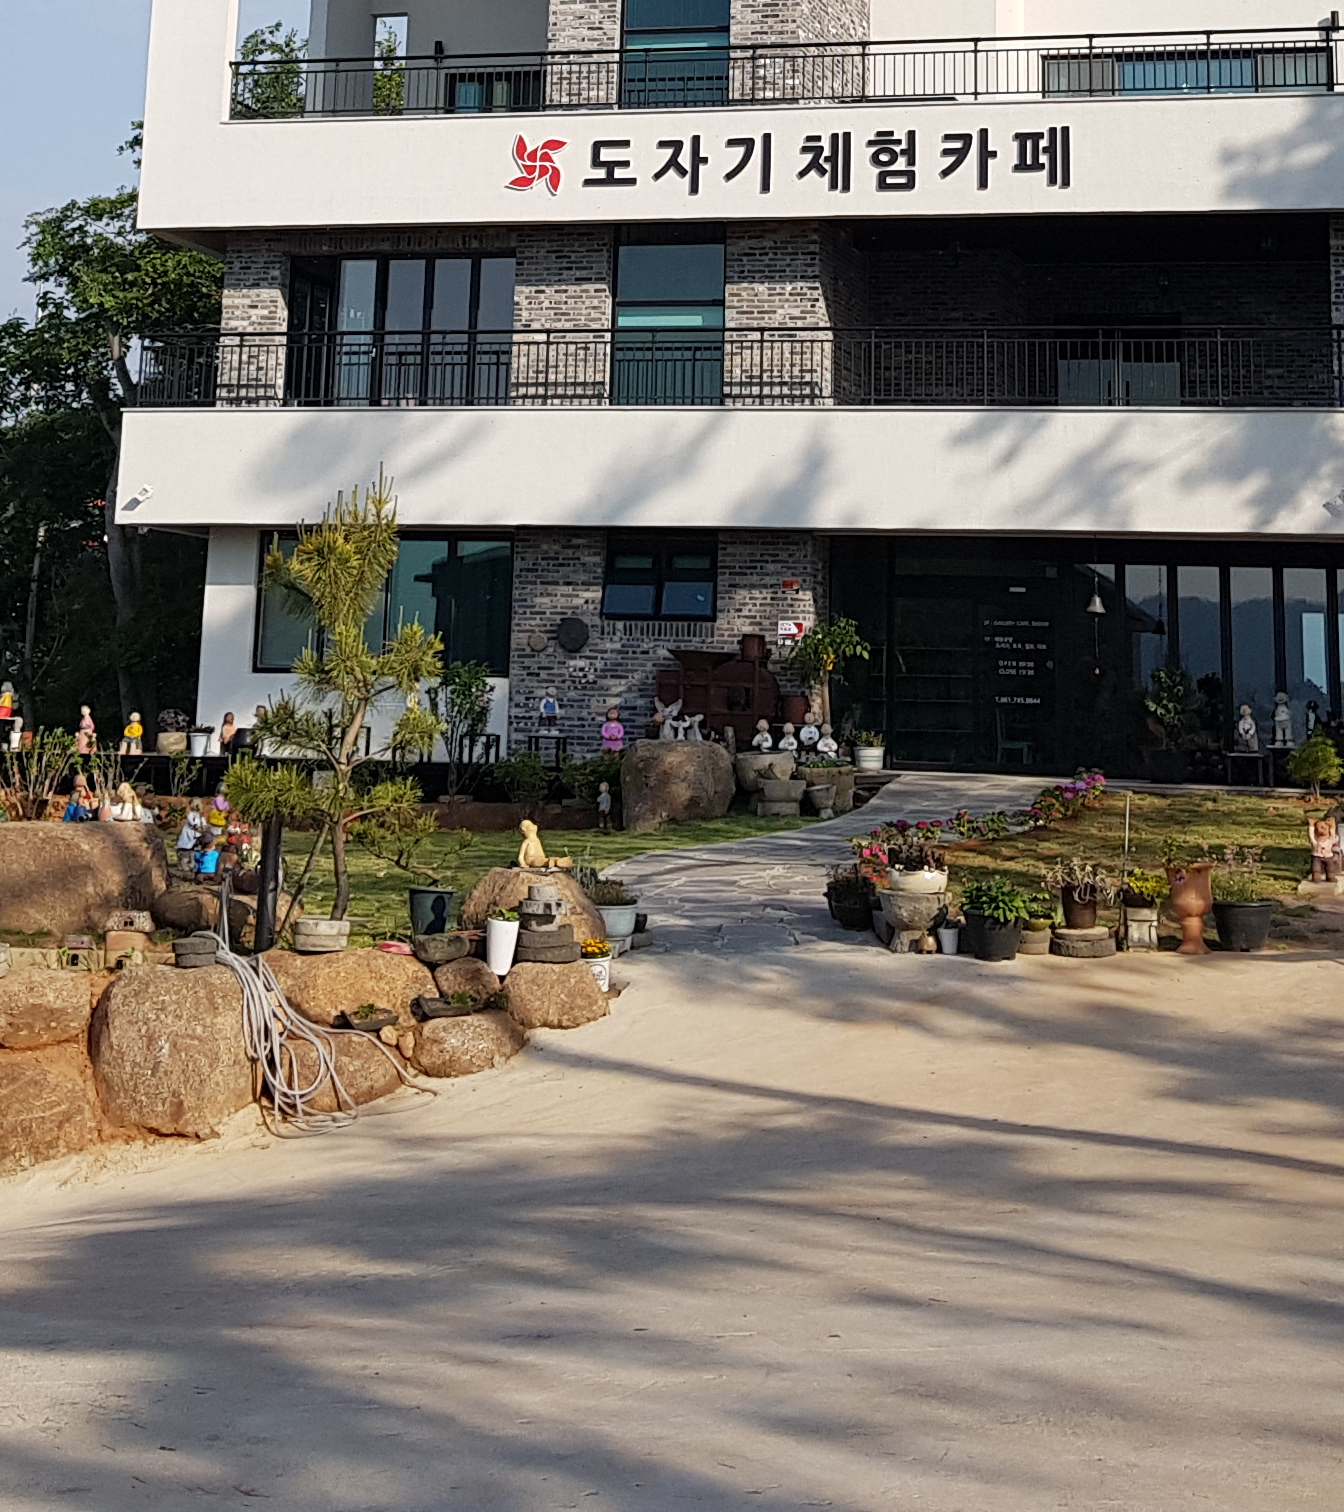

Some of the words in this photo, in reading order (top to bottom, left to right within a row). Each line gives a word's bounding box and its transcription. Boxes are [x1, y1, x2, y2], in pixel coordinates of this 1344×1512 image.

[582, 133, 772, 195] 도자기
[796, 130, 917, 193] 체험
[938, 126, 1071, 191] 카페
